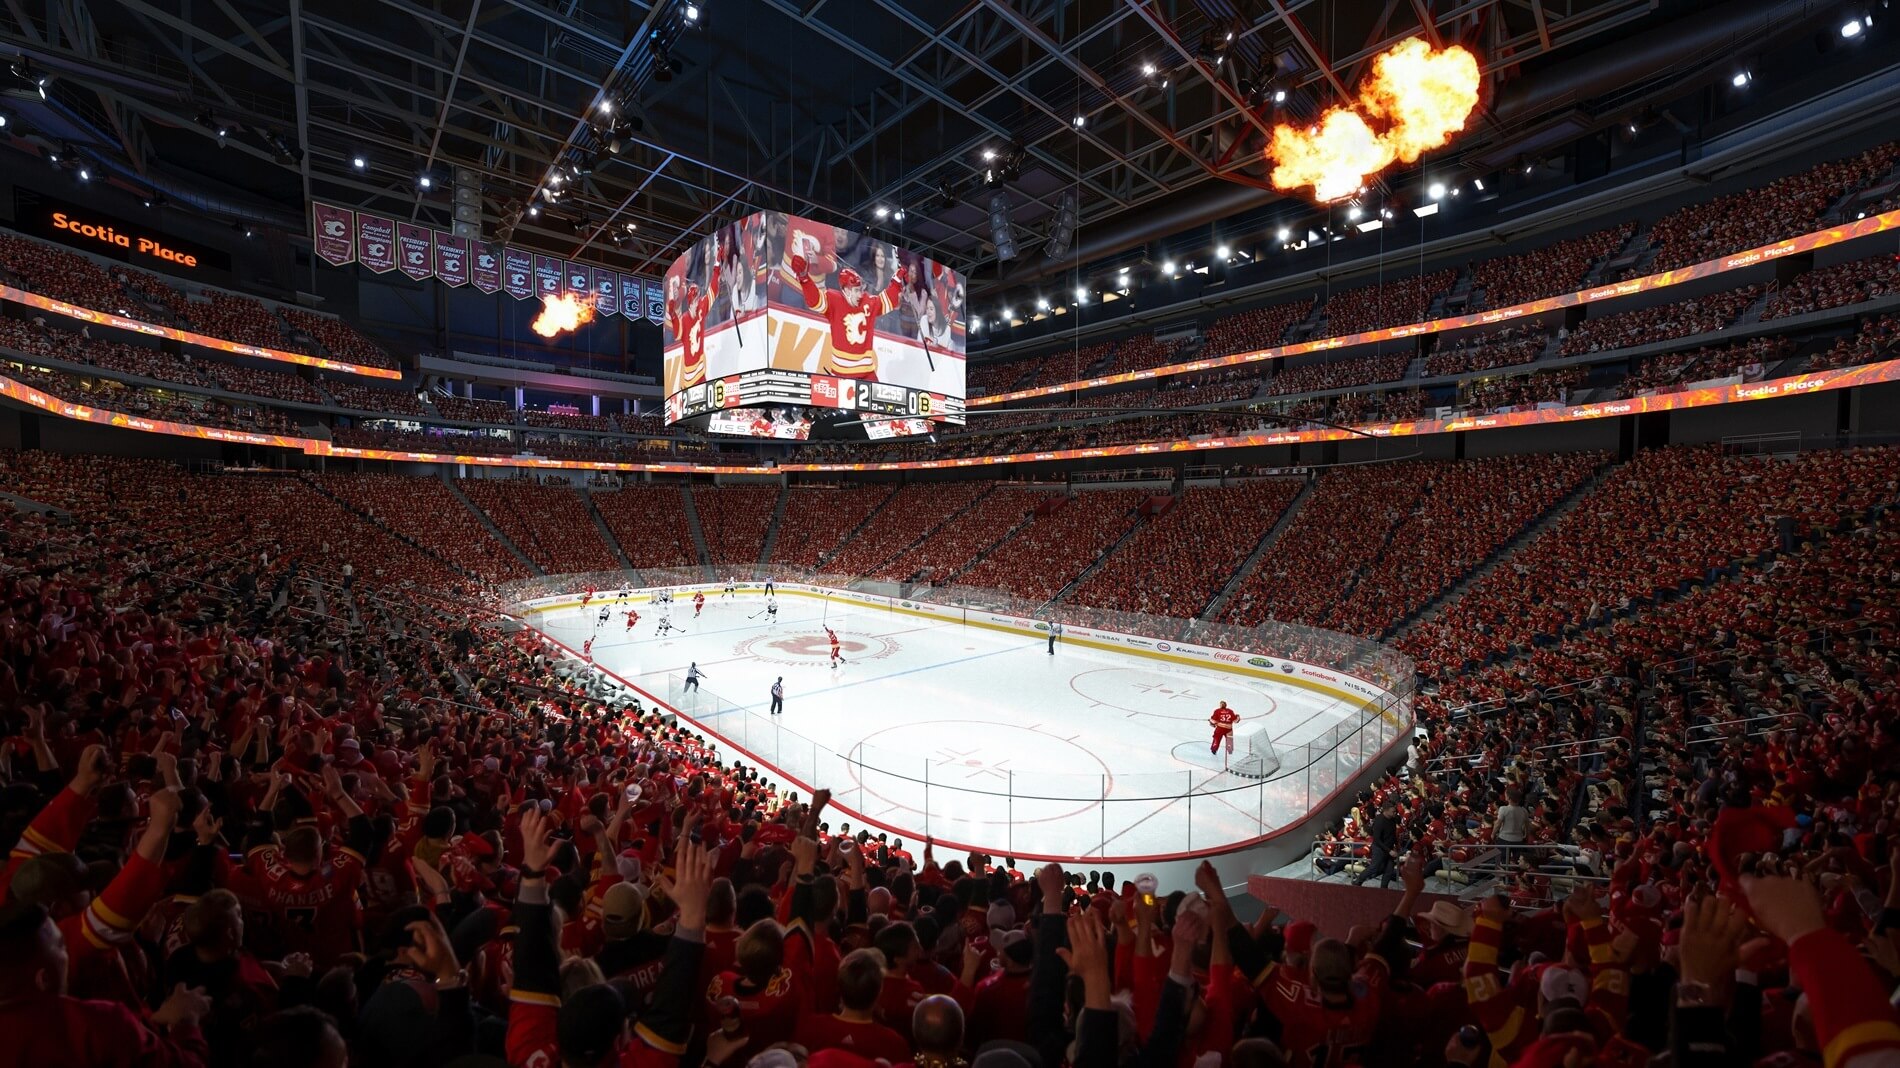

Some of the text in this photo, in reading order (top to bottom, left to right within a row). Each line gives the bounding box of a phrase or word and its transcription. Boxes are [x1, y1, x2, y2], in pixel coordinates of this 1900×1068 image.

[52, 212, 197, 268] Scotia Place
[1727, 245, 1796, 267] Scotia Place
[1590, 284, 1640, 299] Scotia Place
[111, 319, 164, 335] Scotia Place
[858, 384, 869, 408] 2
[1737, 378, 1824, 398] Scotia Place
[909, 392, 916, 415] 0
[921, 398, 929, 412] B
[1573, 404, 1631, 417] Scotia Place
[1095, 634, 1120, 642] NISSAN
[1301, 668, 1337, 683] Scotiabank
[1344, 681, 1377, 698] NISSA
[1220, 714, 1231, 722] 32
